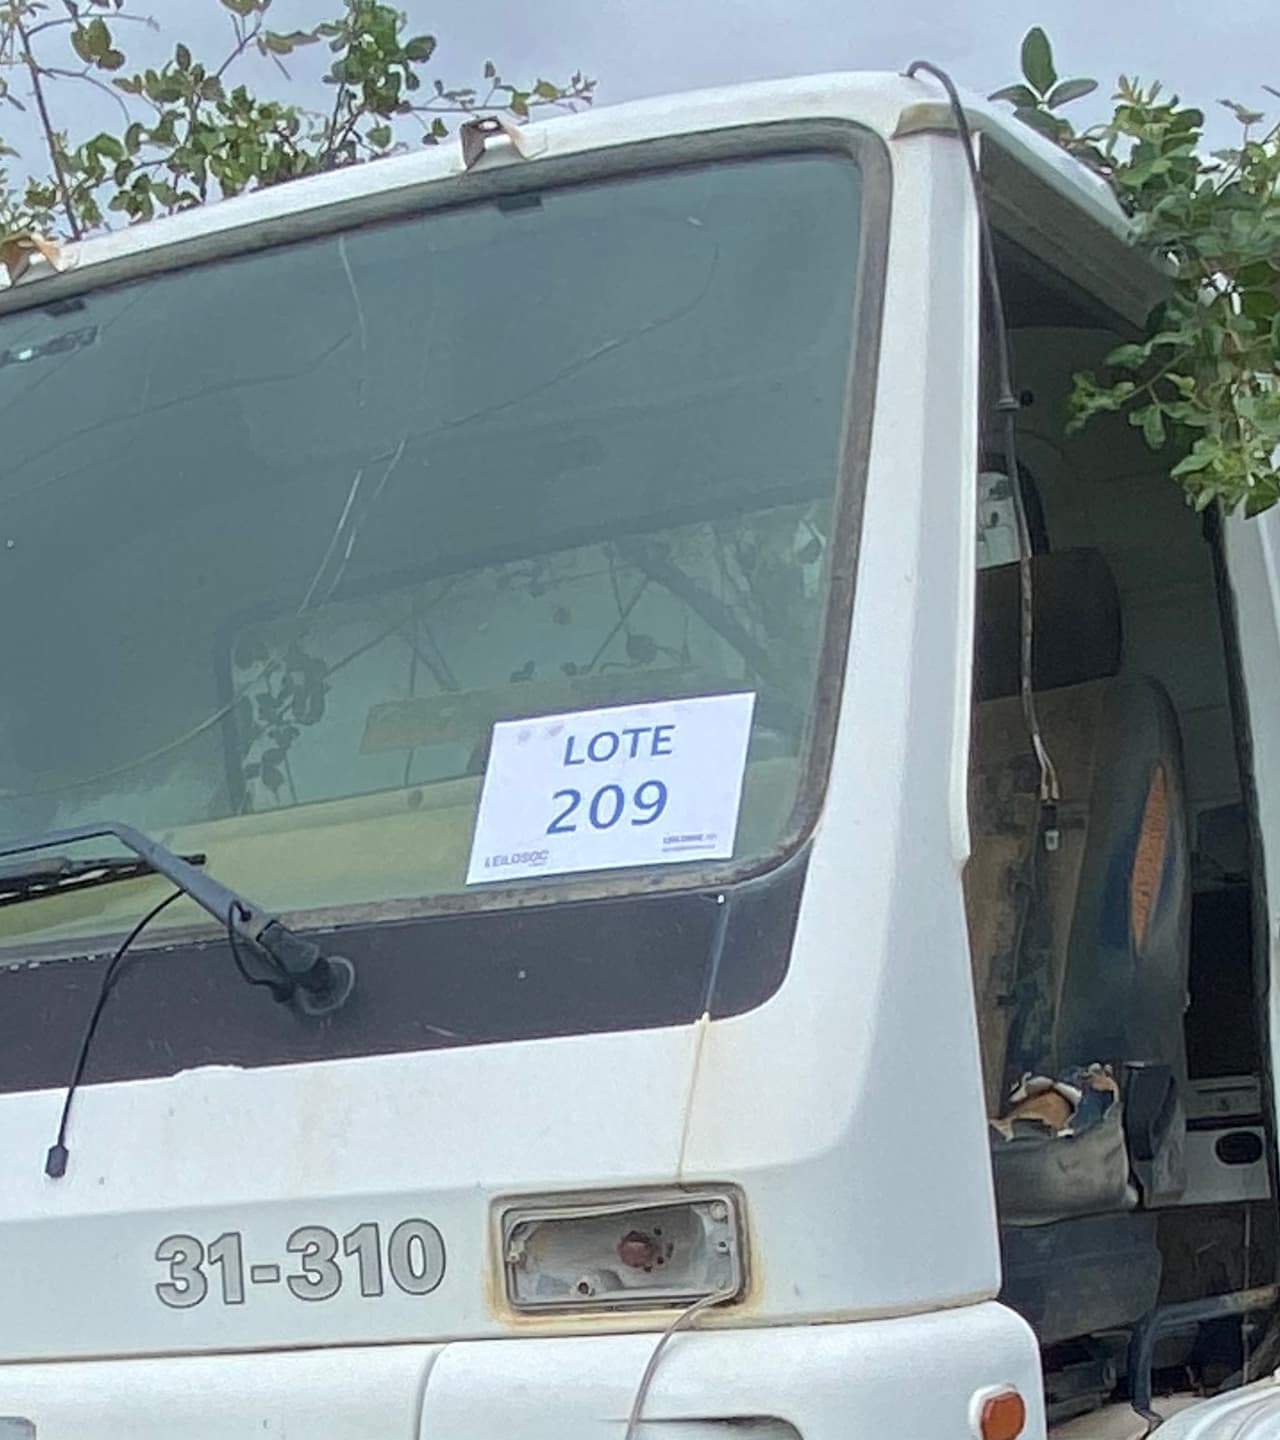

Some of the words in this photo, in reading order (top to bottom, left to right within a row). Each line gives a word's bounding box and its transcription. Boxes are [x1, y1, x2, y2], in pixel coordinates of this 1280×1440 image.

[563, 725, 676, 766] LOTE
[546, 780, 668, 835] 209
[155, 1218, 446, 1308] 31-310
